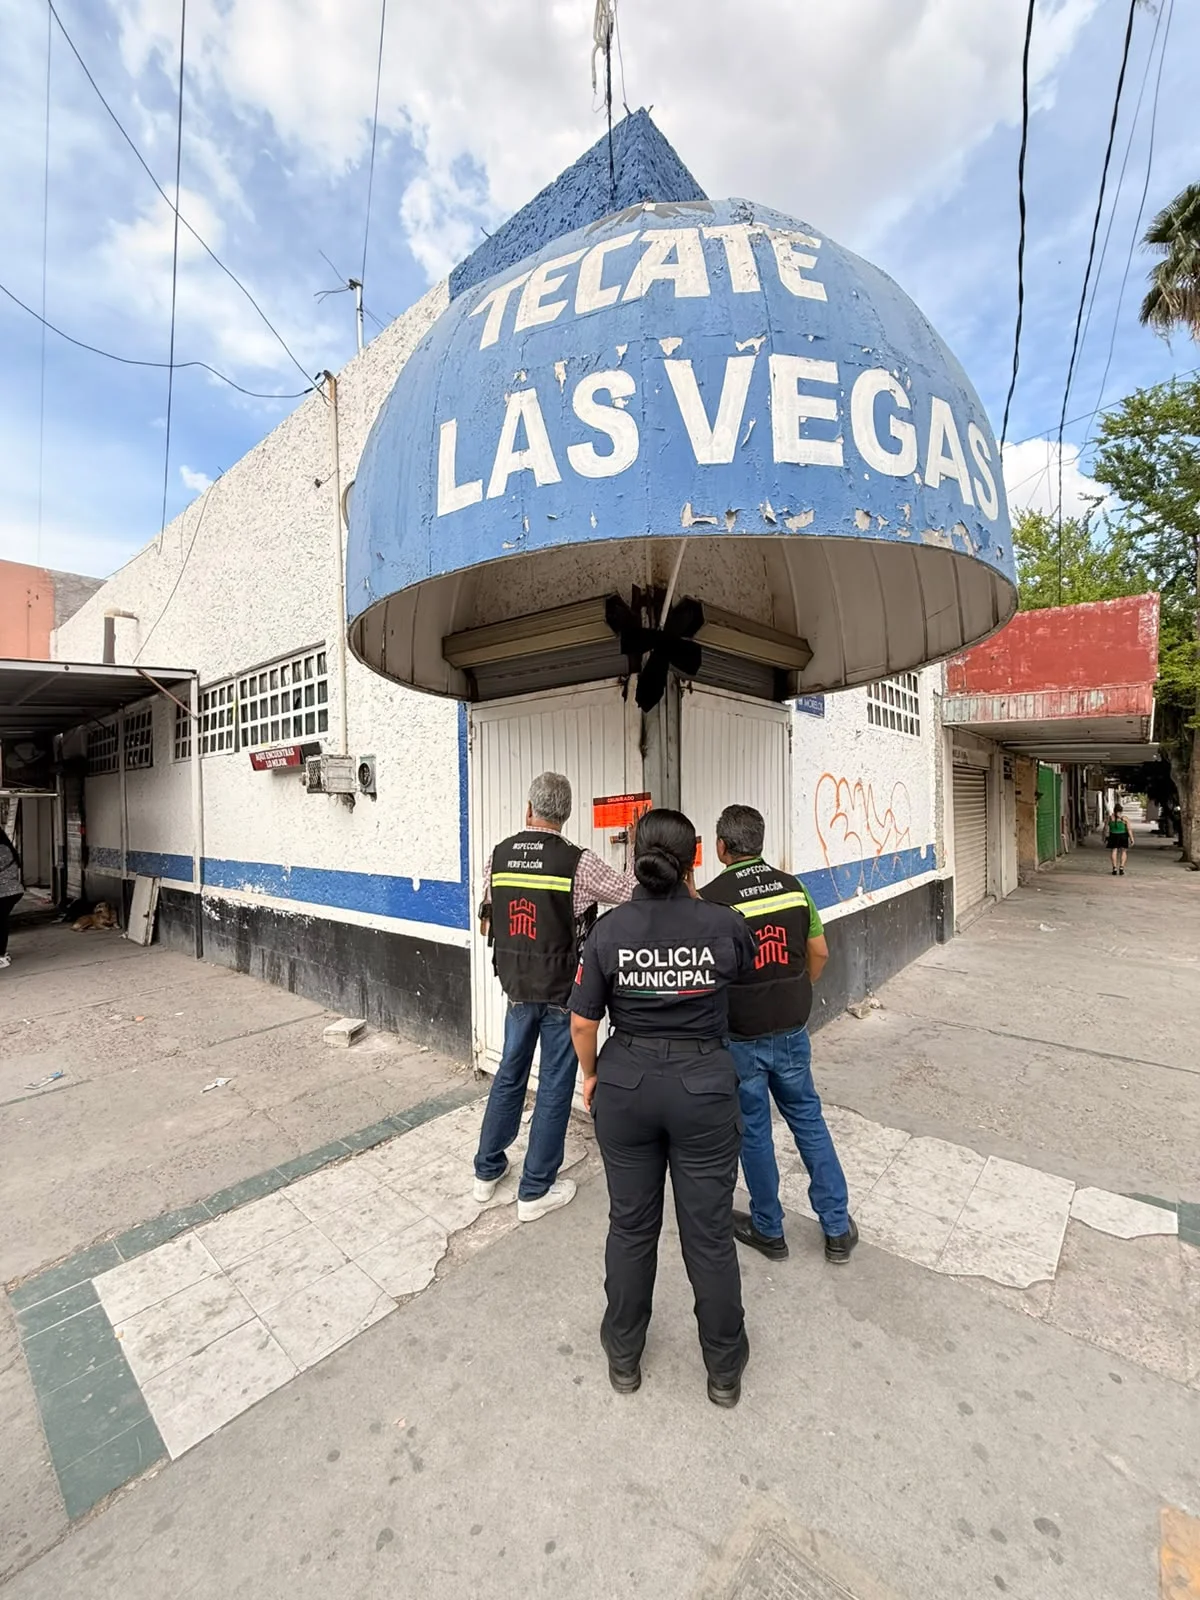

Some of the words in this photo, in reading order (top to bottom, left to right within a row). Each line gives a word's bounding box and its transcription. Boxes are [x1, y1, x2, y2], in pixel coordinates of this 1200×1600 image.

[469, 222, 828, 350] TECATE
[437, 368, 640, 517] LAS
[664, 354, 999, 521] VEGAS
[512, 840, 544, 851] INSPECCIÓN
[523, 851, 528, 859] Y
[507, 859, 543, 869] VERIFICACIÓN
[739, 880, 784, 898] VERIFICACIÓN
[618, 946, 716, 968] POLICIA
[618, 970, 716, 987] MUNICIPAL
